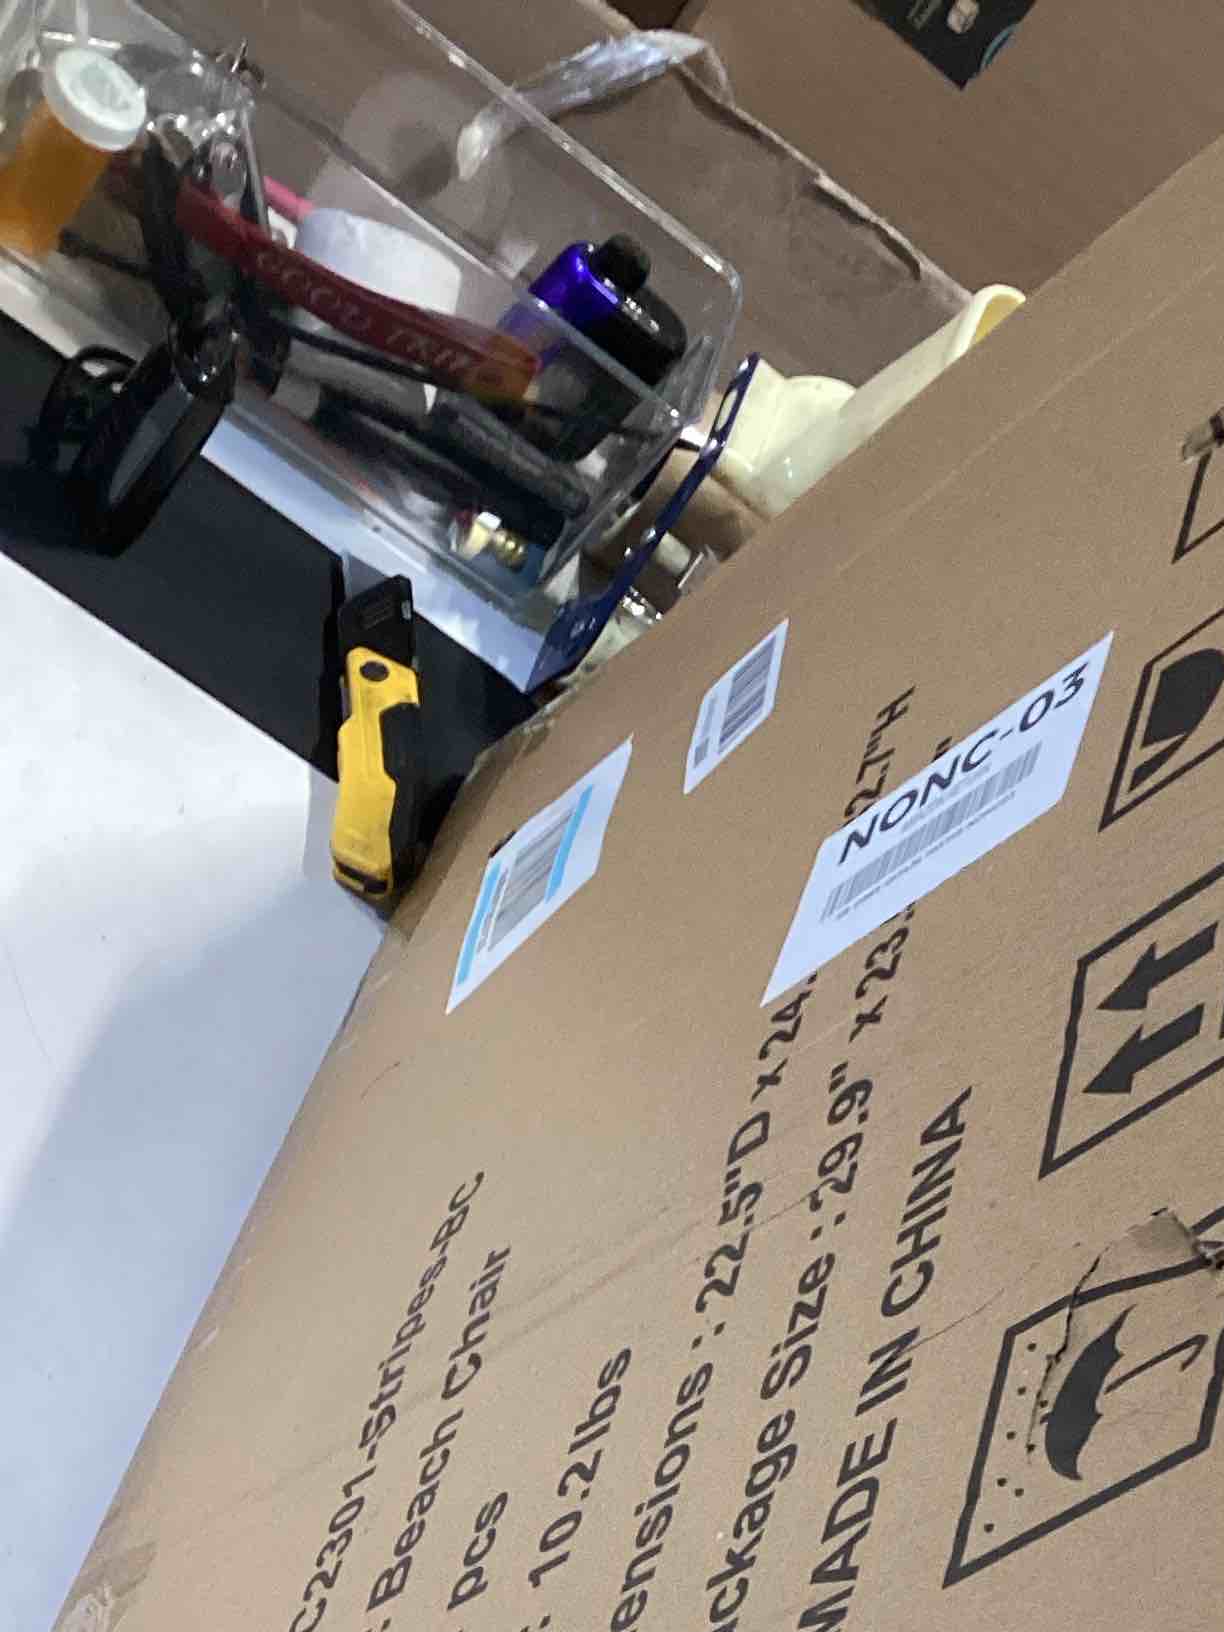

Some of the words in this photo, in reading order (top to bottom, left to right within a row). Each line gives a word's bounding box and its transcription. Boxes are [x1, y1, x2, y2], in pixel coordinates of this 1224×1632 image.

[838, 661, 1089, 866] NONC-03
[694, 1110, 771, 1314] 22.5"D
[757, 972, 818, 1061] 24.
[840, 686, 916, 830] 2.7"H
[759, 1252, 836, 1401] Size
[854, 902, 916, 1001] 23.
[880, 1085, 973, 1318] CHINA
[365, 1407, 464, 1613] Beach
[440, 1245, 512, 1401] Chair
[854, 1327, 921, 1418] IN
[446, 1491, 509, 1612] pcs
